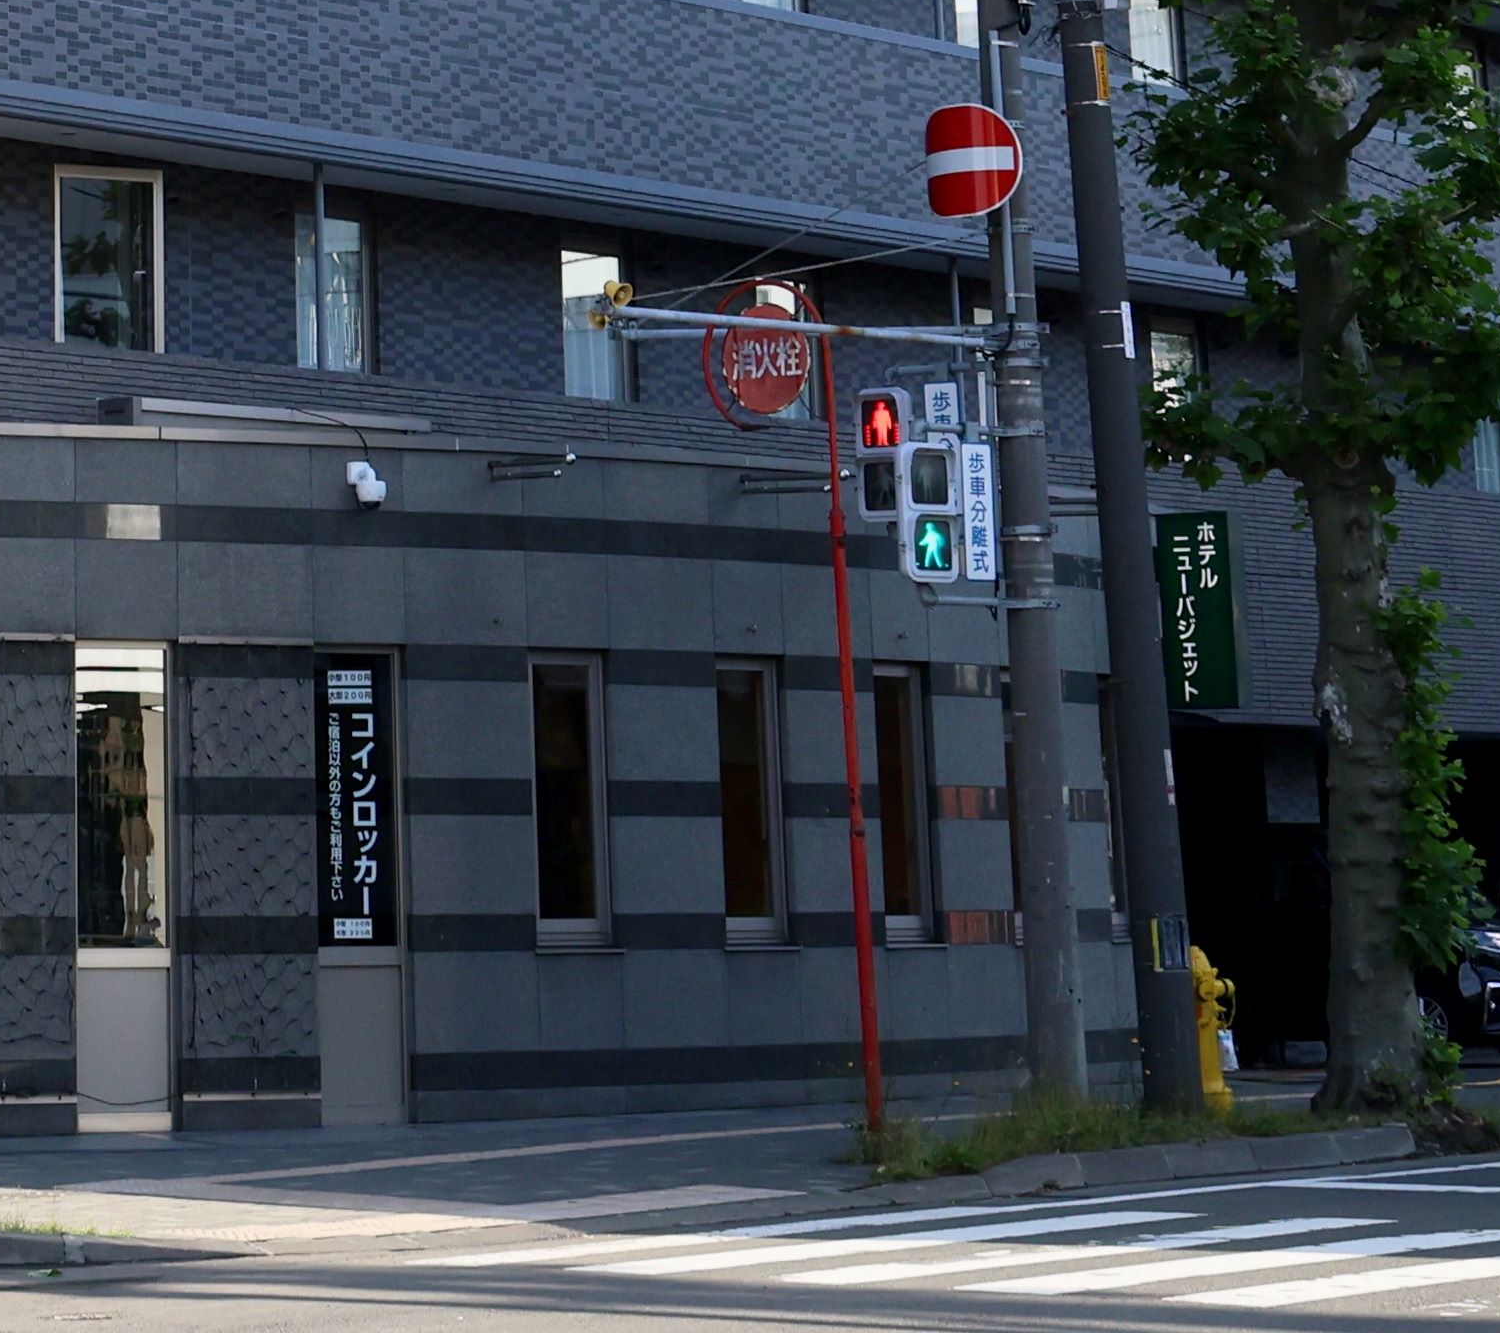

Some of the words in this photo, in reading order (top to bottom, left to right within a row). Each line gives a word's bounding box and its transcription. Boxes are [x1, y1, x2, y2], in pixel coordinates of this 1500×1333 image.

[732, 336, 803, 380] 消火栓
[968, 451, 990, 573] 歩車分離式
[1197, 521, 1218, 589] ホテル
[1173, 536, 1199, 703] ニューバジェット
[328, 712, 343, 901] ご宿泊以外の方もご利用下さい
[350, 713, 378, 915] コインロッカー
